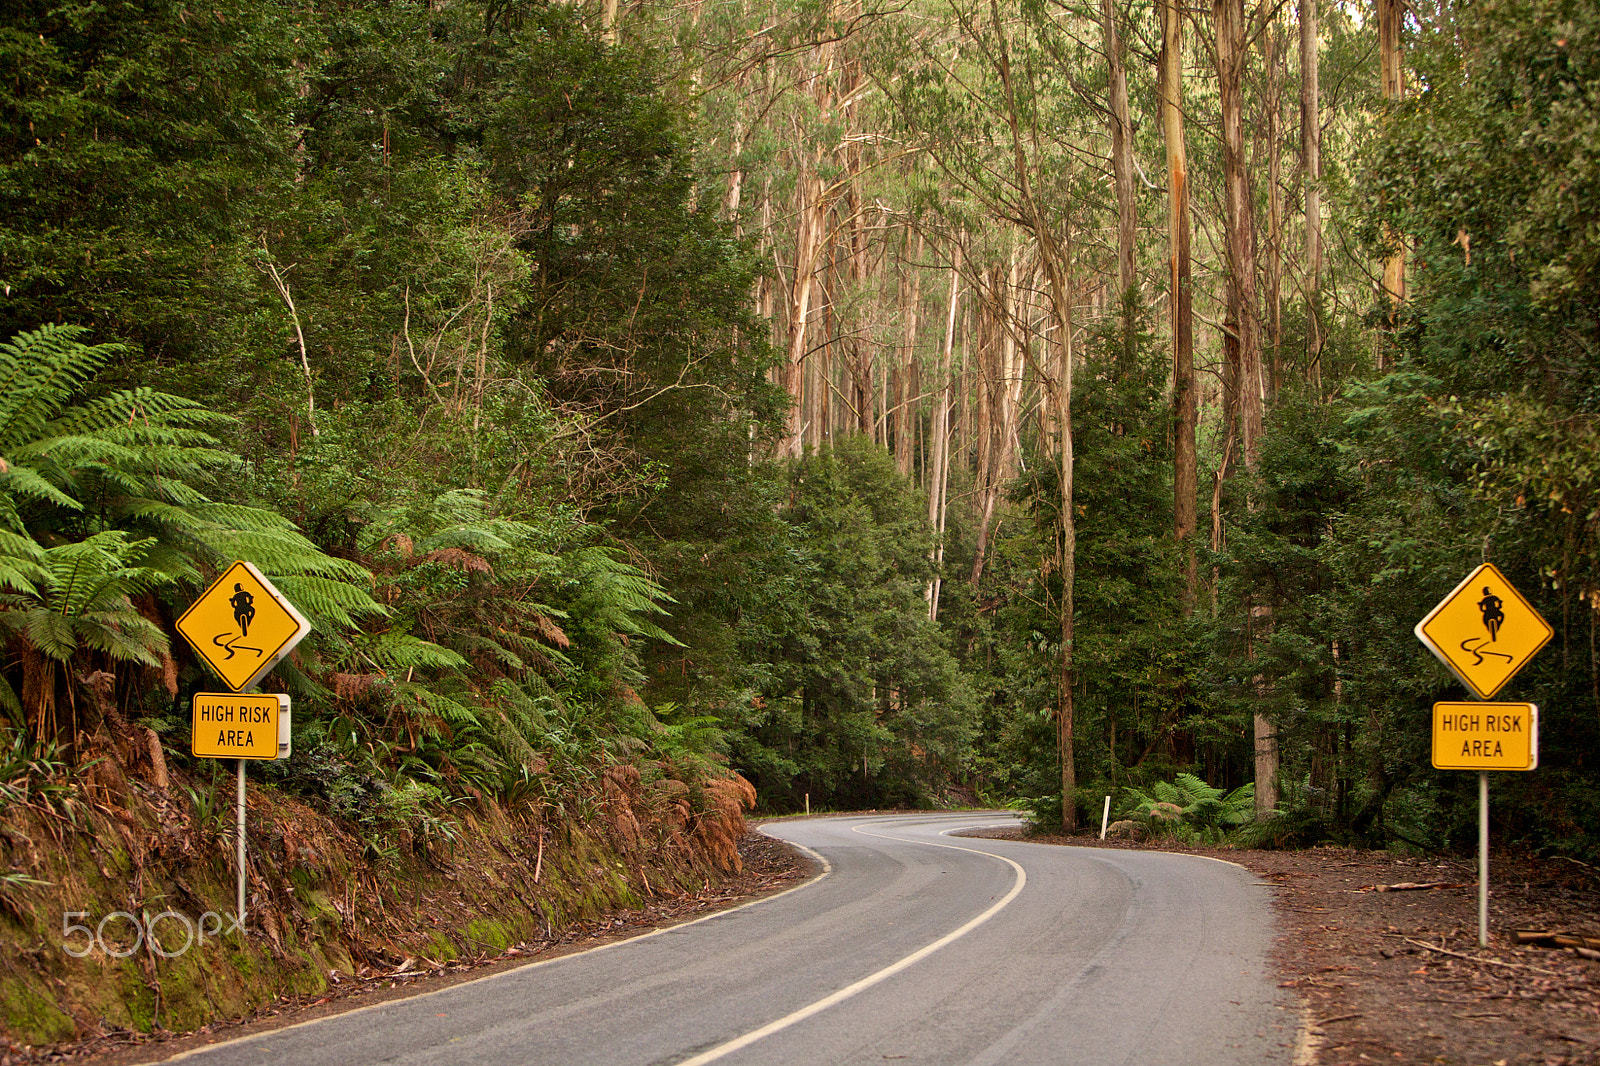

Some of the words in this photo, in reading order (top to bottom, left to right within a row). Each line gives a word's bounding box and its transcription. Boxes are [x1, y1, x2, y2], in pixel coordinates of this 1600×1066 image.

[201, 705, 234, 722] HIGH
[239, 706, 271, 723] RISK
[1442, 714, 1479, 732] HIGH
[1486, 715, 1522, 732] RISK
[217, 730, 254, 747] AREA
[1461, 740, 1503, 757] AREA
